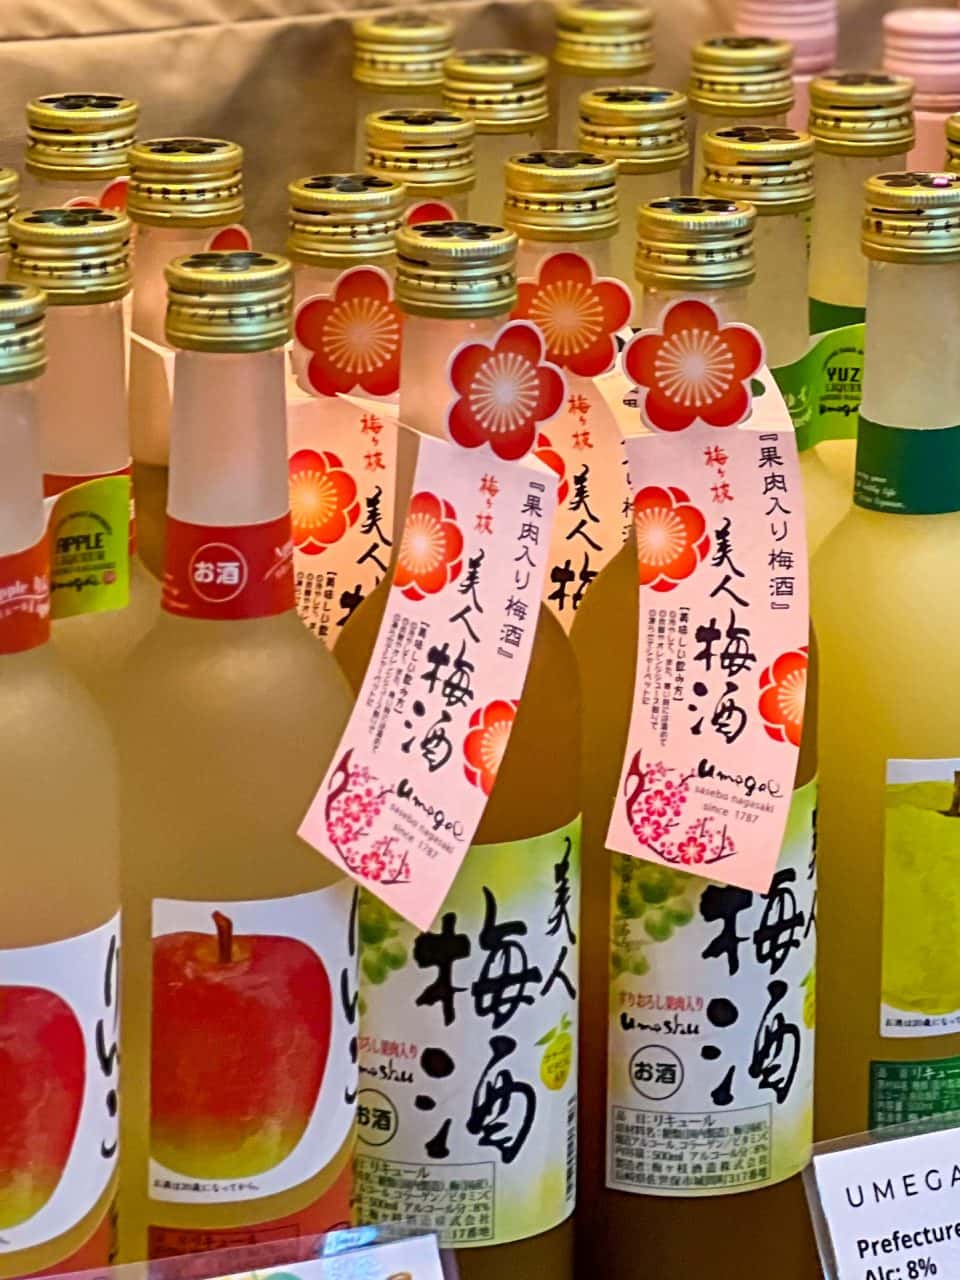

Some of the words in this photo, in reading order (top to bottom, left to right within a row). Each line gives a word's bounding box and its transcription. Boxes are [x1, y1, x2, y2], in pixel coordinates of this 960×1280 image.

[758, 433, 796, 611] 『果肉入り梅酒』
[194, 561, 240, 585] お酒
[497, 481, 546, 660] 『果肉入り梅酒』
[703, 803, 729, 817] since
[735, 809, 760, 824] 1787
[413, 885, 543, 1164] 梅酒
[634, 1061, 677, 1084] お酒
[357, 1105, 392, 1131] お酒
[906, 1256, 938, 1279] 8%
